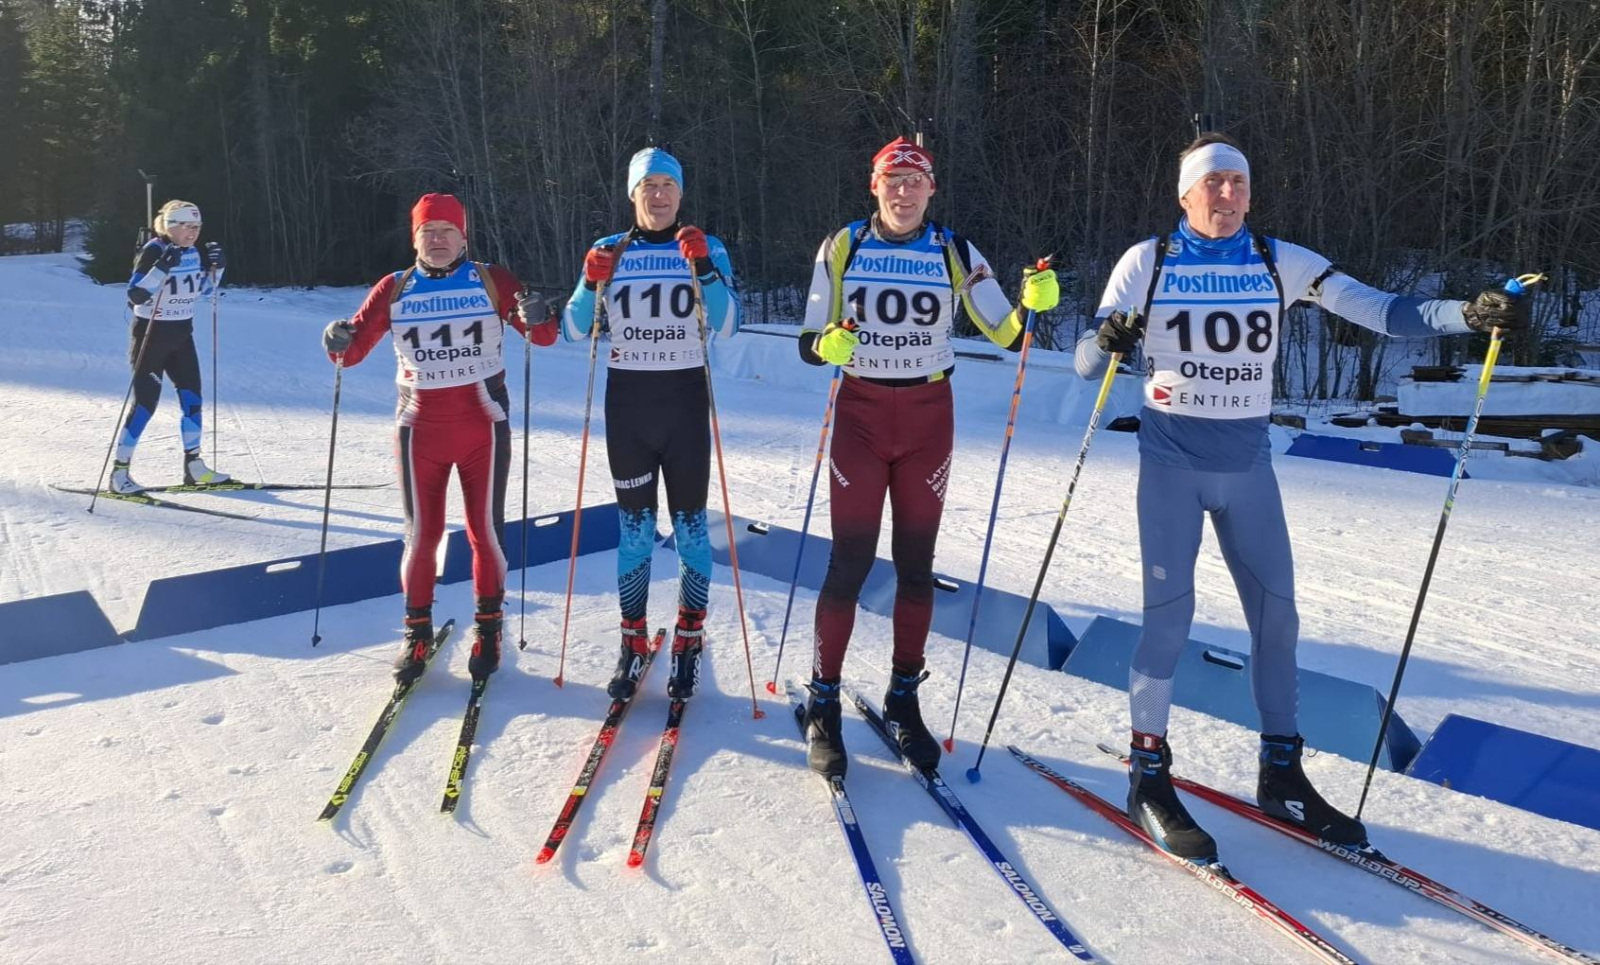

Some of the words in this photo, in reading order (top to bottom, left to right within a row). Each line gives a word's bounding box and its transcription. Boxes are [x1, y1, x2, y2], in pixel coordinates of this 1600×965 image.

[615, 255, 692, 272] Postimee
[851, 255, 944, 278] Postimees
[1162, 272, 1274, 294] Postimees
[400, 294, 489, 315] Postimees
[614, 283, 696, 319] 110
[848, 286, 941, 326] 109
[402, 320, 484, 349] 111
[623, 325, 686, 344] Otepää
[858, 331, 932, 350] Otepää
[1166, 310, 1272, 353] 108
[414, 344, 482, 363] Otepää
[624, 352, 677, 361] ENTIRE
[859, 356, 923, 369] ENTIRE
[417, 365, 476, 381] ENTIRE
[1180, 361, 1262, 385] Otepää
[1180, 392, 1251, 408] ENTIRE
[994, 860, 1056, 922] SALOMON
[866, 881, 905, 948] SALOMON
